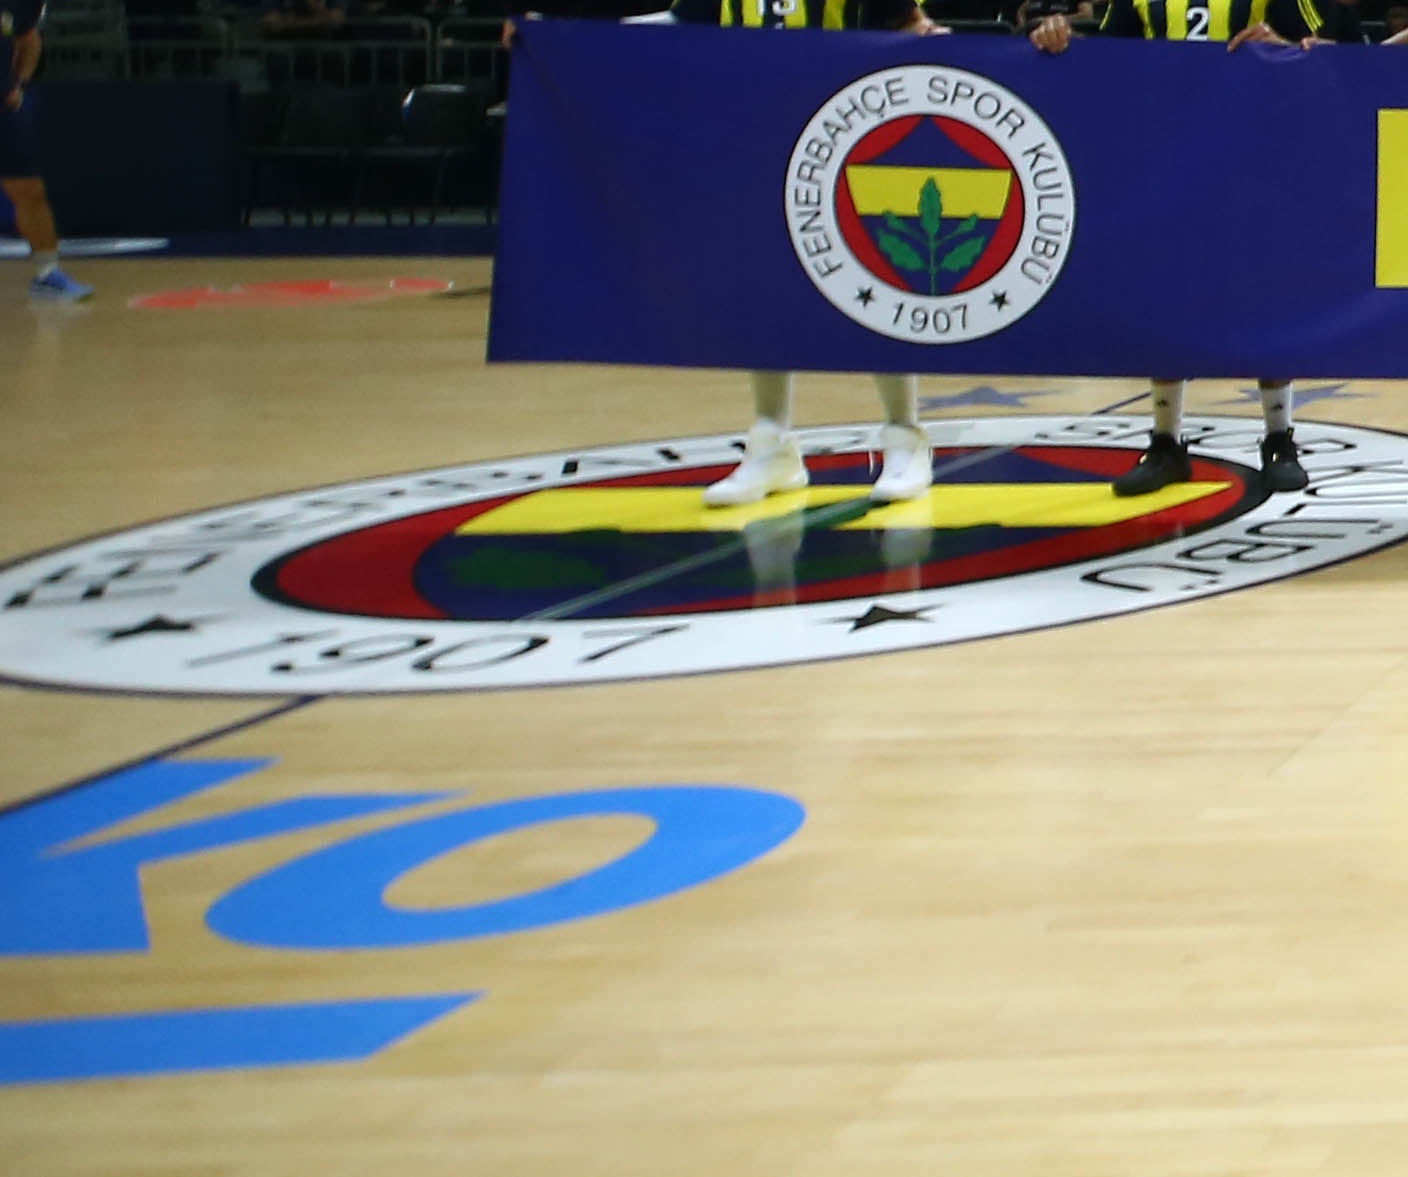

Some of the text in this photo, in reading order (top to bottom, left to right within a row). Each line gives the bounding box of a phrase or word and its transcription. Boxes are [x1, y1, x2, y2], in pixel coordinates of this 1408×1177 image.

[1186, 7, 1211, 41] 2
[795, 75, 1070, 286] FENERBAHÇE SPOR KULÜBÜ
[891, 302, 969, 335] 1907
